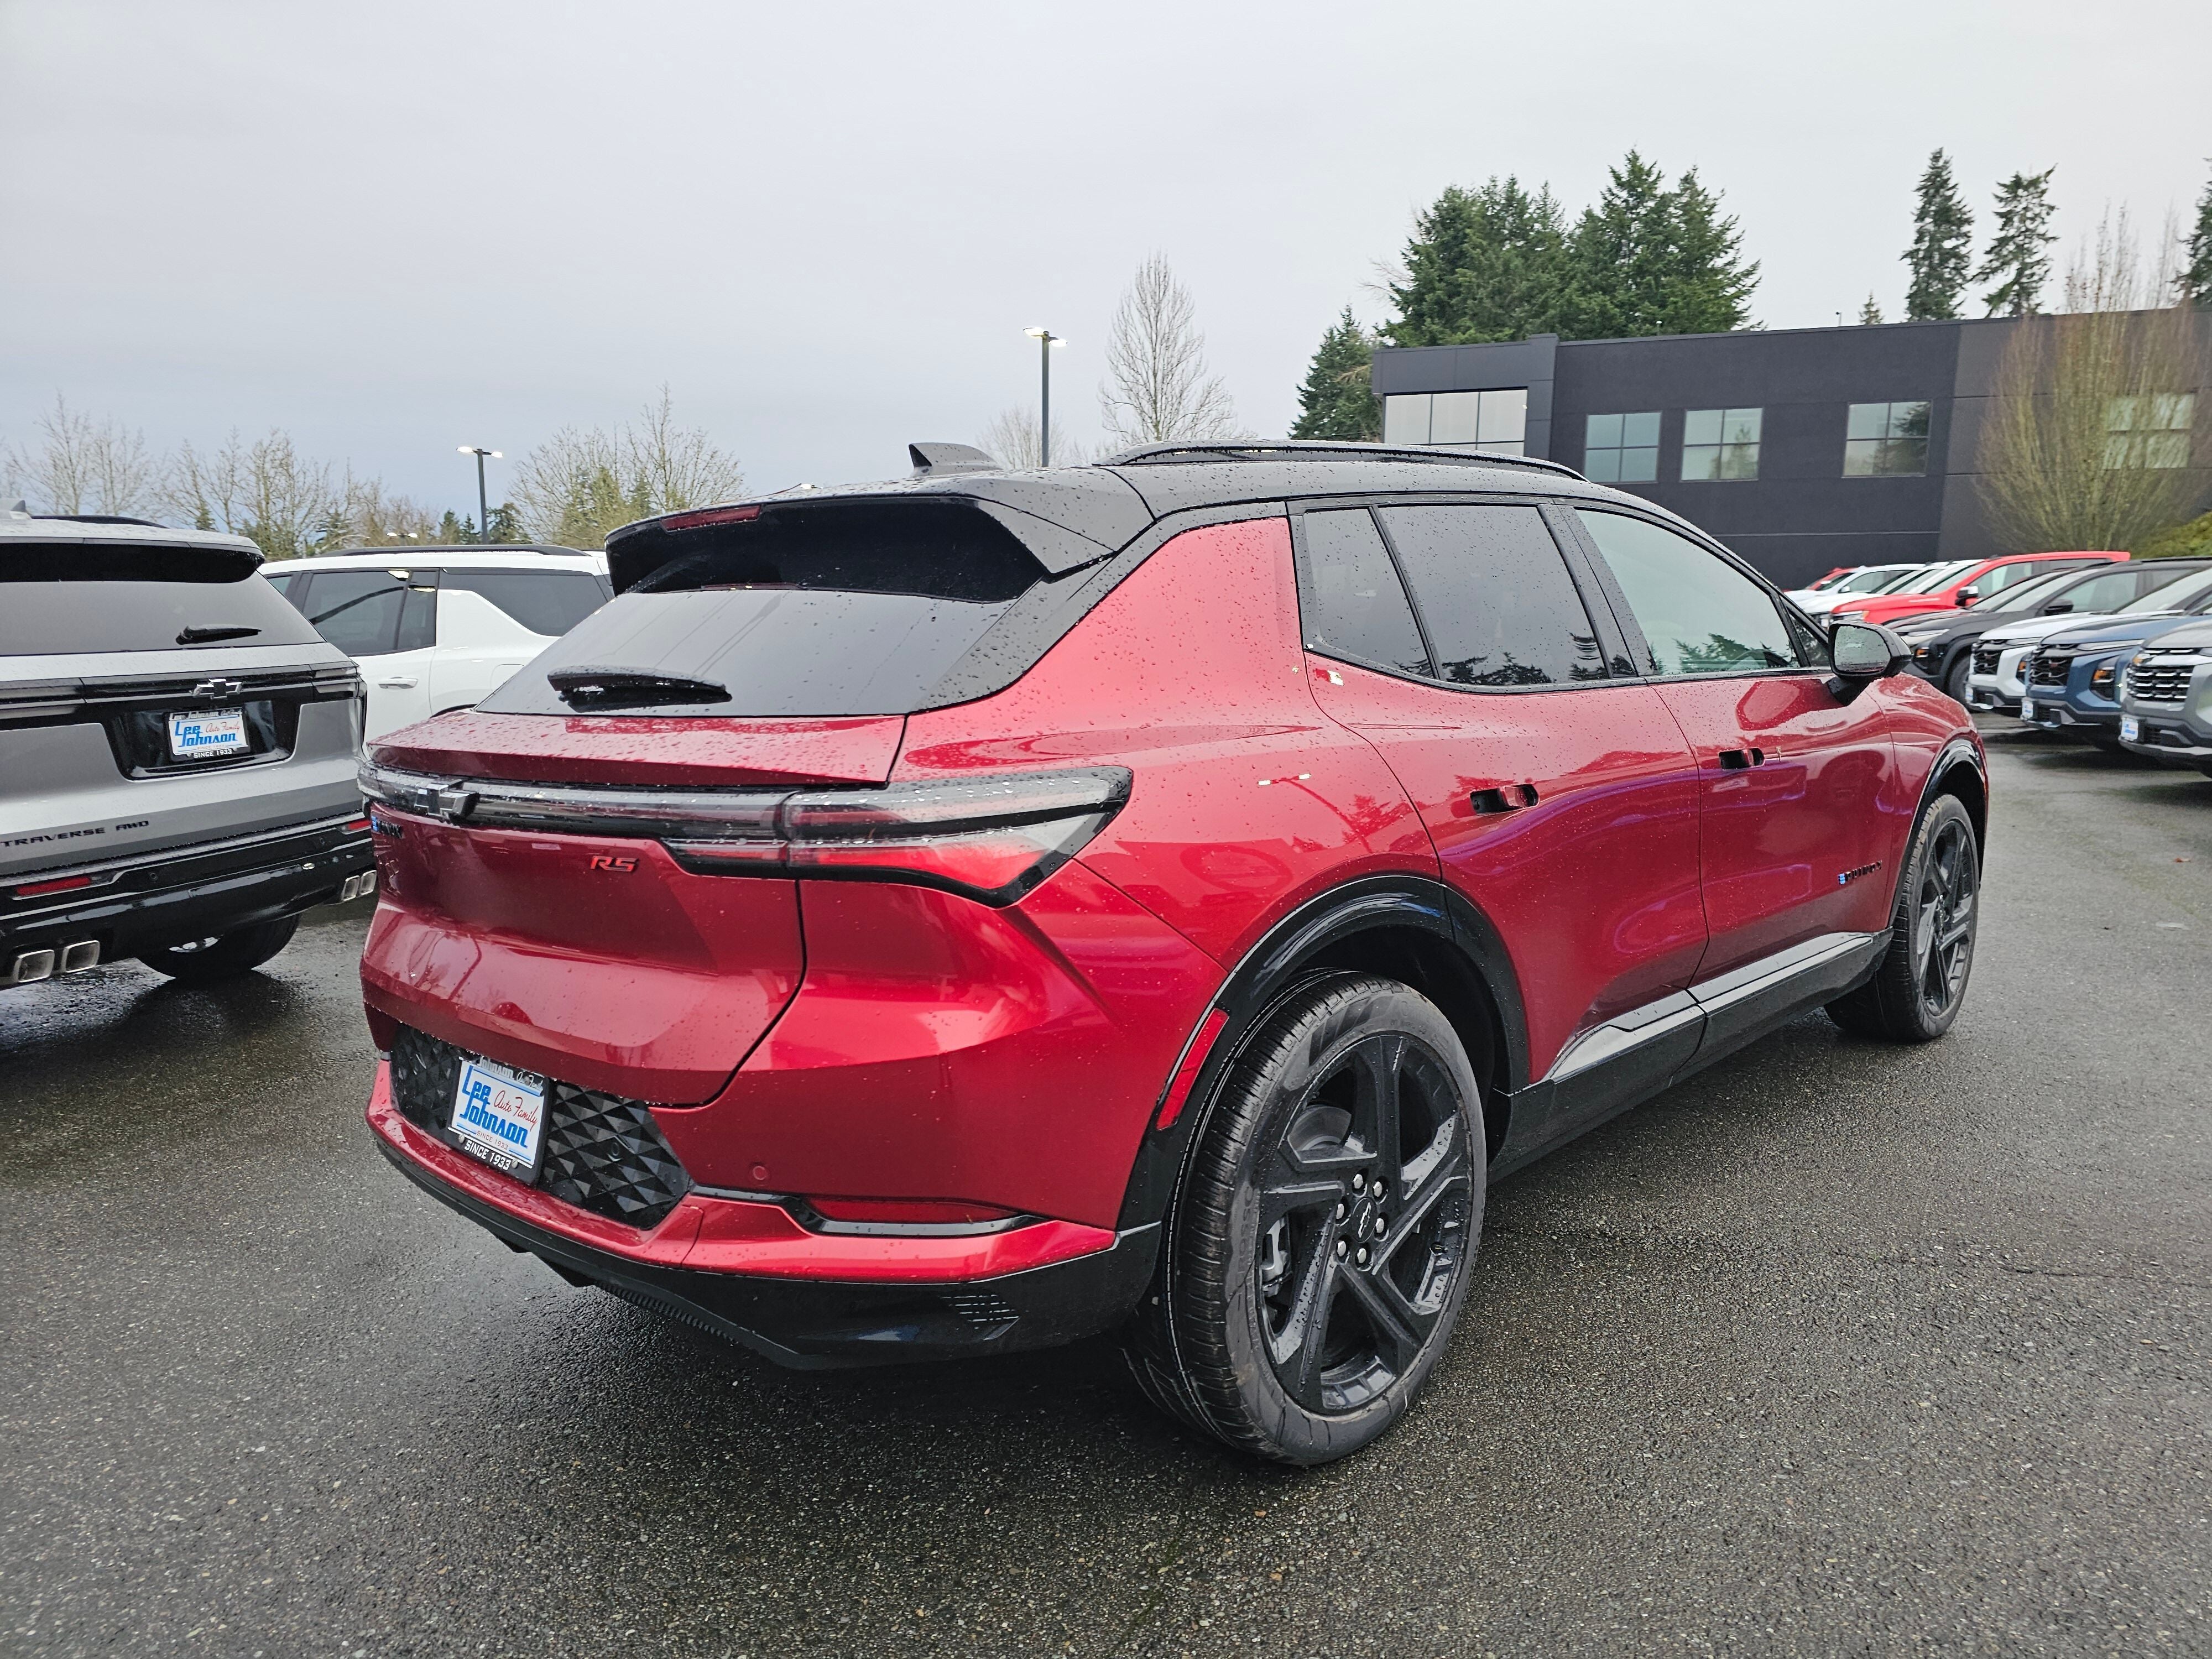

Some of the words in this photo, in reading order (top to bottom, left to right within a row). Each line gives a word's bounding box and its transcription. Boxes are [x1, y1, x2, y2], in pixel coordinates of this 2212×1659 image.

[175, 722, 203, 736] Lee
[206, 723, 220, 733] Auto
[221, 721, 241, 733] Family
[178, 732, 238, 747] Johnson
[1, 827, 105, 847] TRAVERSE
[116, 821, 149, 831] AWD
[590, 855, 639, 872] RS
[477, 1056, 515, 1080] Johnson
[462, 1065, 492, 1104] Lee
[494, 1090, 512, 1113] Auto
[513, 1097, 539, 1131] Family
[459, 1098, 528, 1149] Johnson
[477, 1130, 493, 1142] SINCE
[494, 1139, 509, 1151] 1933
[464, 1140, 489, 1160] SINCE
[490, 1152, 512, 1171] 1933
